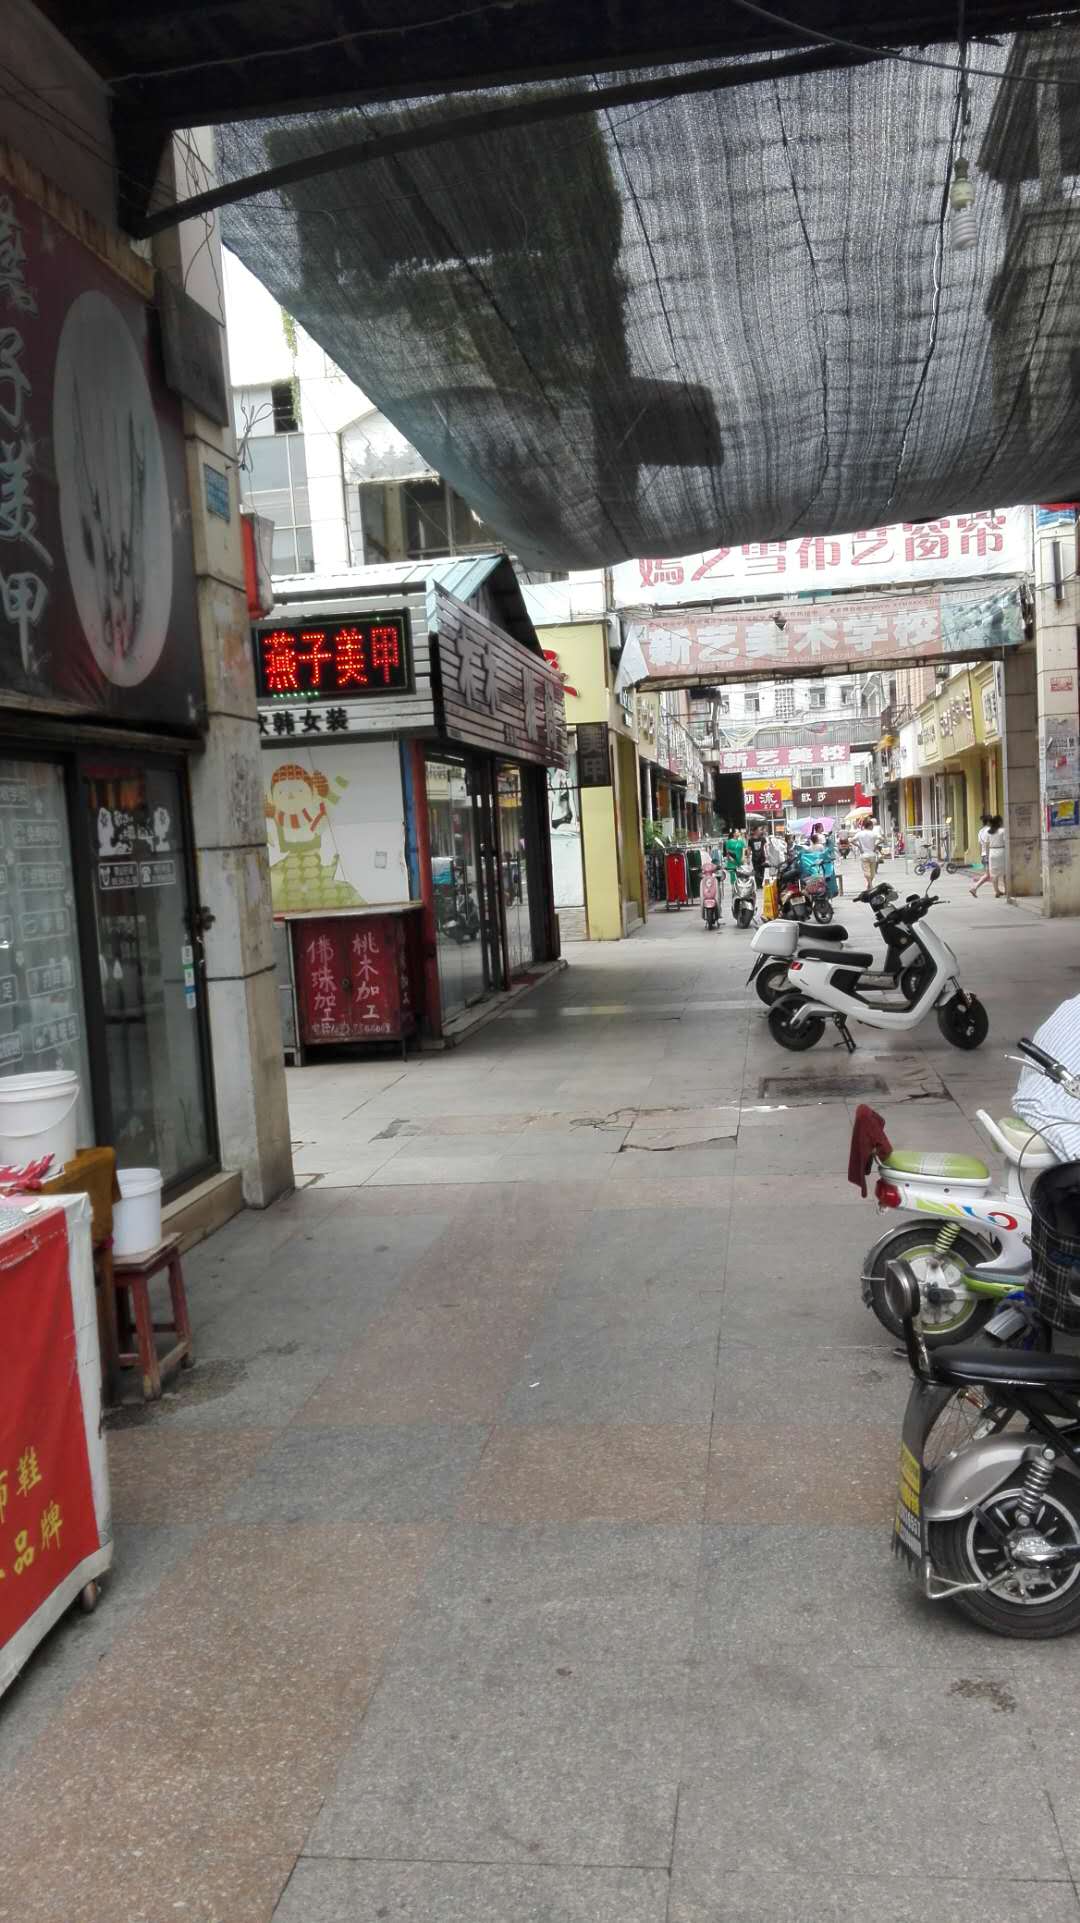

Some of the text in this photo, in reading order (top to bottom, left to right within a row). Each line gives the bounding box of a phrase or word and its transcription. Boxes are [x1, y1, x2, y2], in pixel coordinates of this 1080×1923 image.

[264, 627, 400, 688] 燕子美甲
[648, 610, 939, 664] 新艺美术学校
[722, 745, 846, 767] 新艺美校
[306, 934, 337, 1022] 佛珠加工
[352, 931, 380, 1019] 桃木加工
